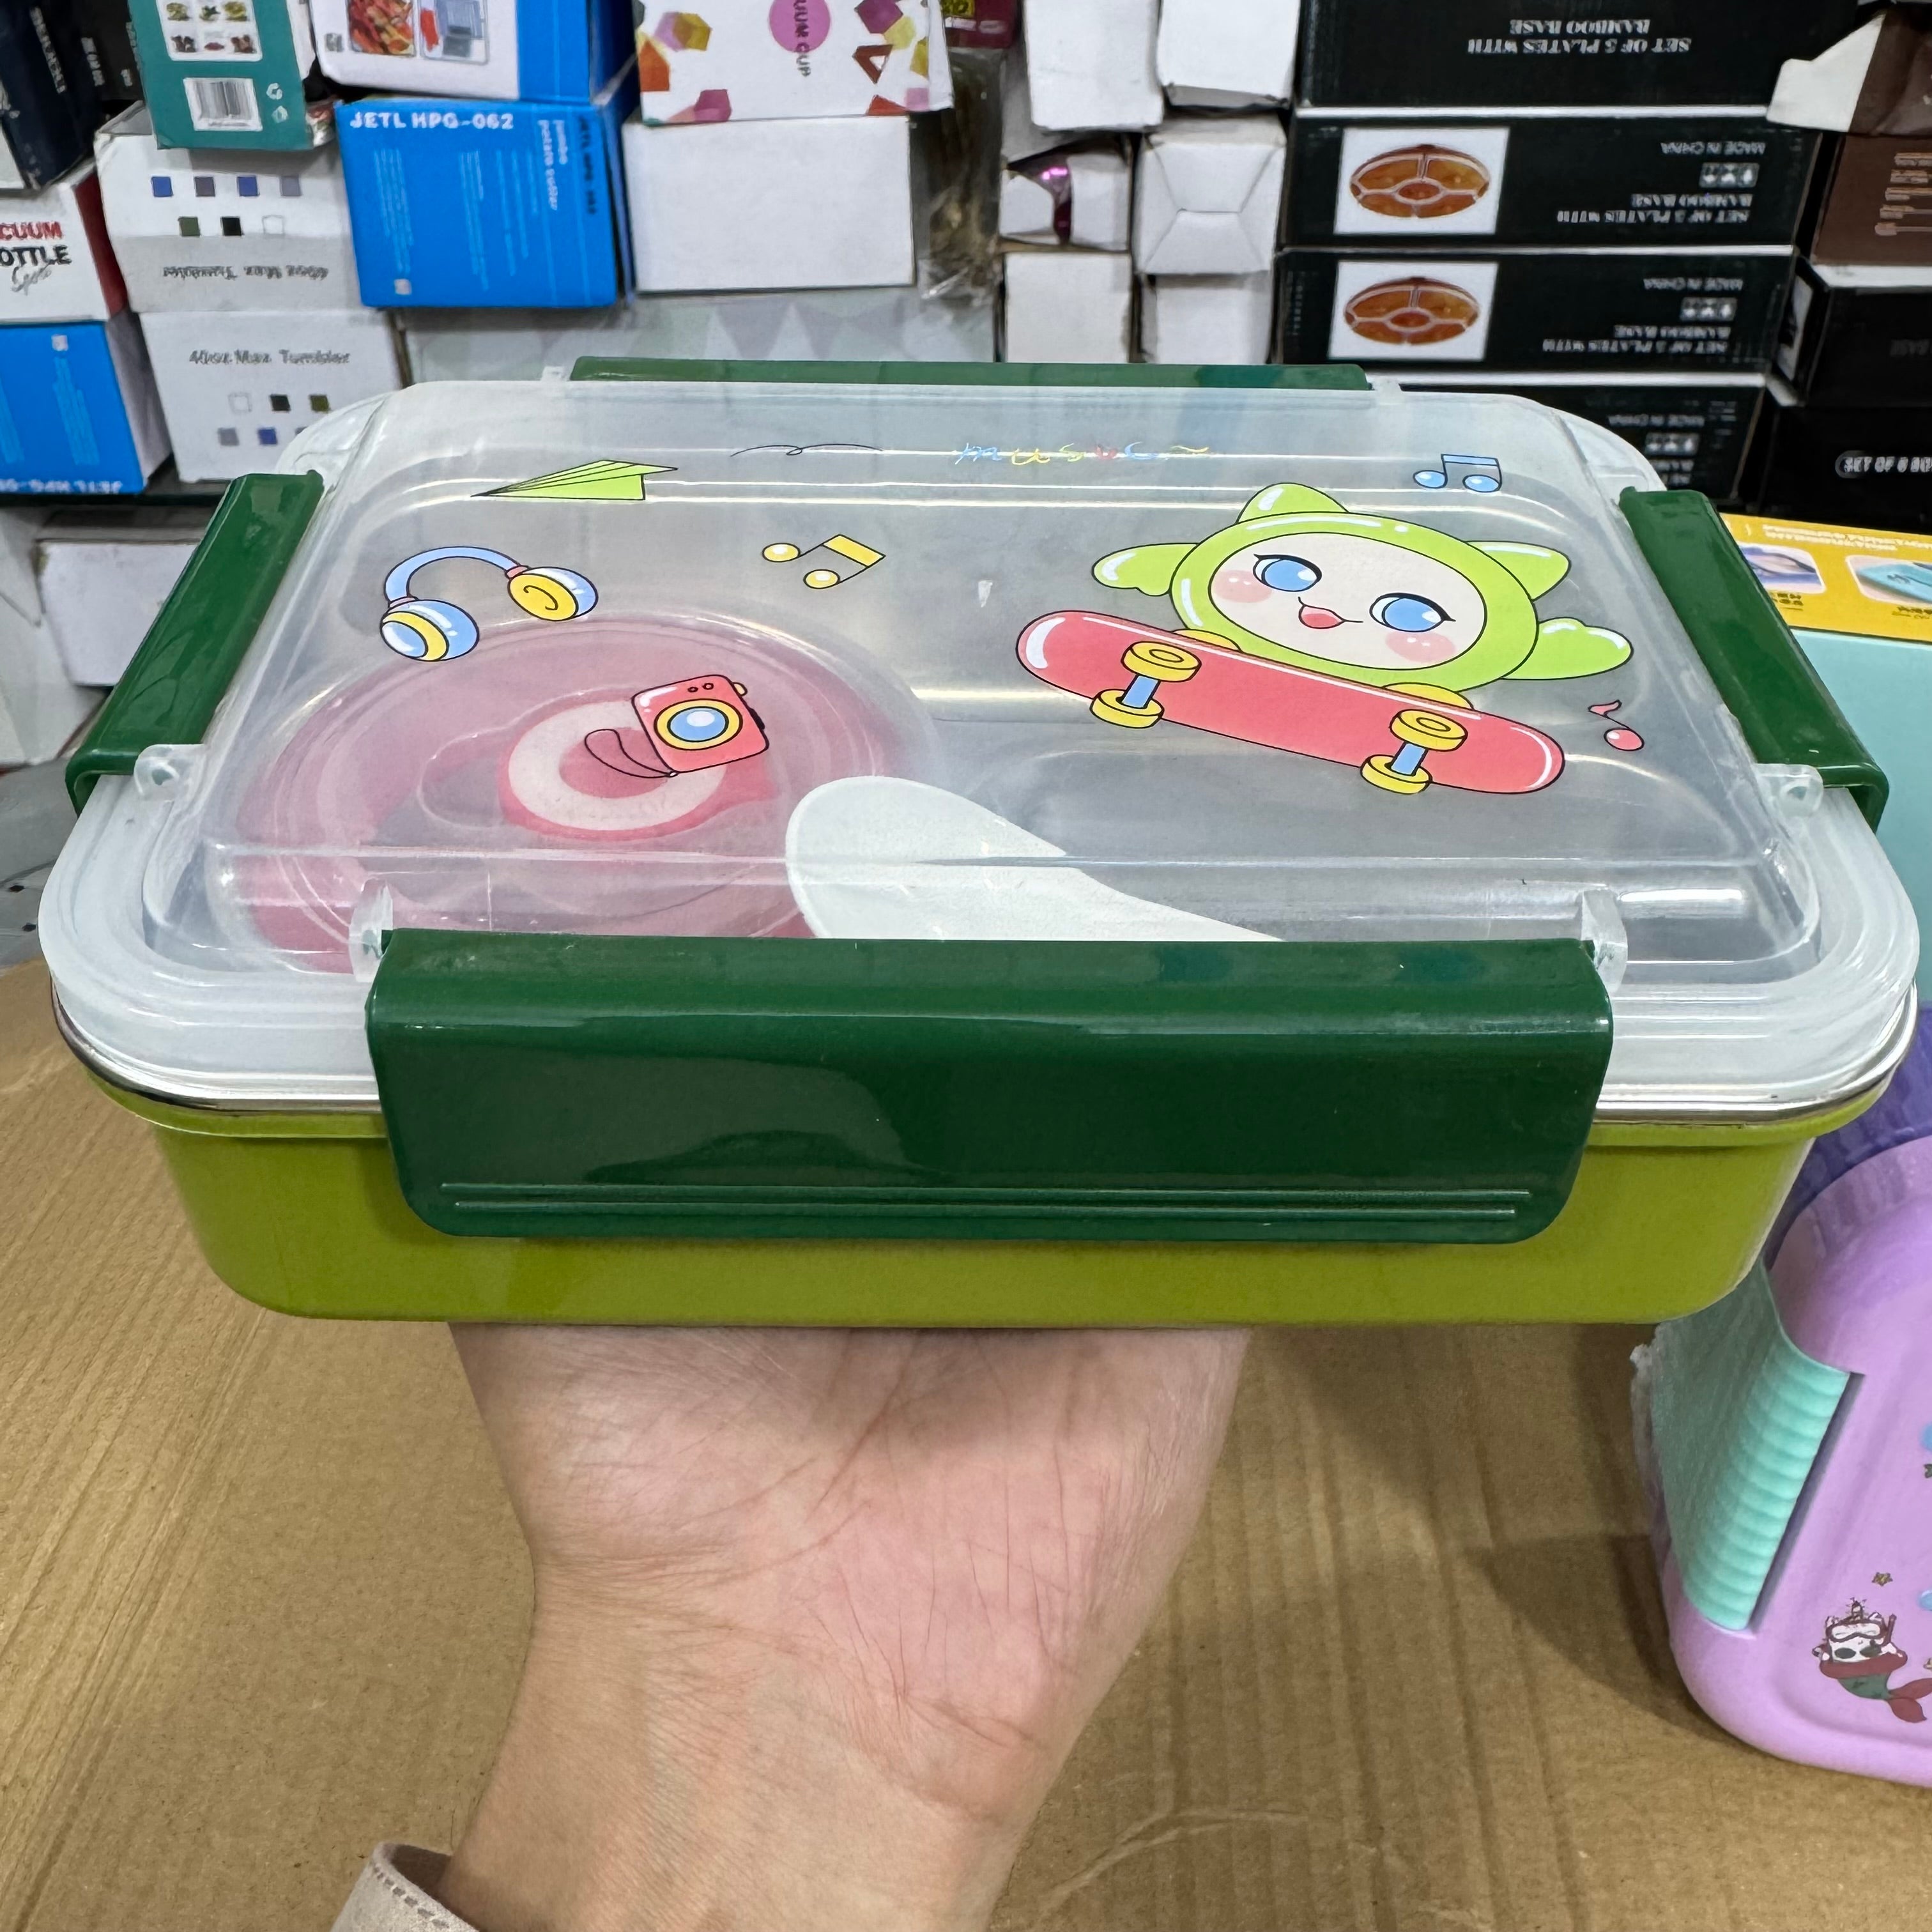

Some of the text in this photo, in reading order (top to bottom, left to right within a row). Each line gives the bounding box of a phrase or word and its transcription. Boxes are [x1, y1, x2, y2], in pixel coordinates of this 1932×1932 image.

[1510, 19, 1651, 34] BAMBOO BASE
[1468, 38, 1518, 54] WITH
[1523, 38, 1600, 54] PLATES
[1621, 38, 1648, 53] OF
[1652, 37, 1692, 53] SET
[795, 42, 811, 77] CUP
[350, 112, 406, 128] JETL
[1660, 142, 1766, 155] MADE IN CHINA
[1844, 456, 1873, 473] SET
[1874, 456, 1896, 473] OF
